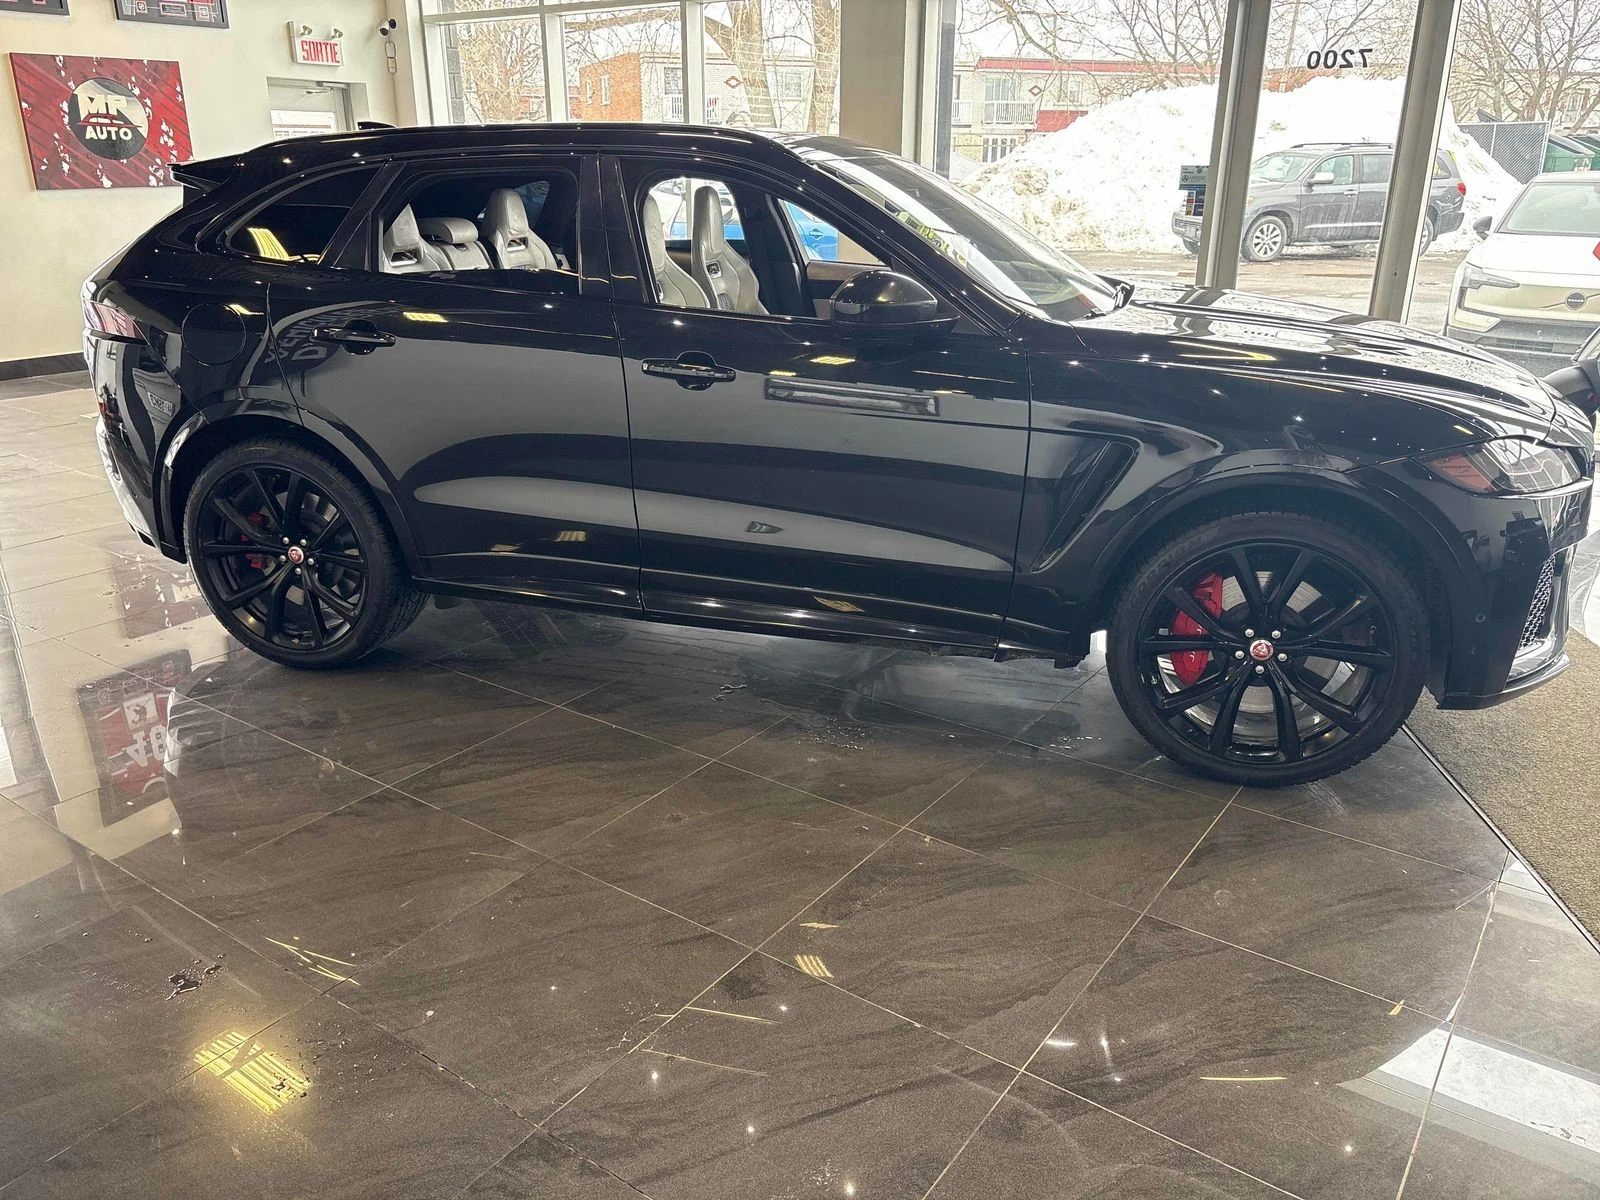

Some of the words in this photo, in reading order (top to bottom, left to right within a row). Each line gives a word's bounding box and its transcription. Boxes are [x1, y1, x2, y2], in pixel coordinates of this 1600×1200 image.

[300, 40, 340, 63] SORTIE
[77, 93, 128, 121] MR
[85, 126, 132, 140] AUTO
